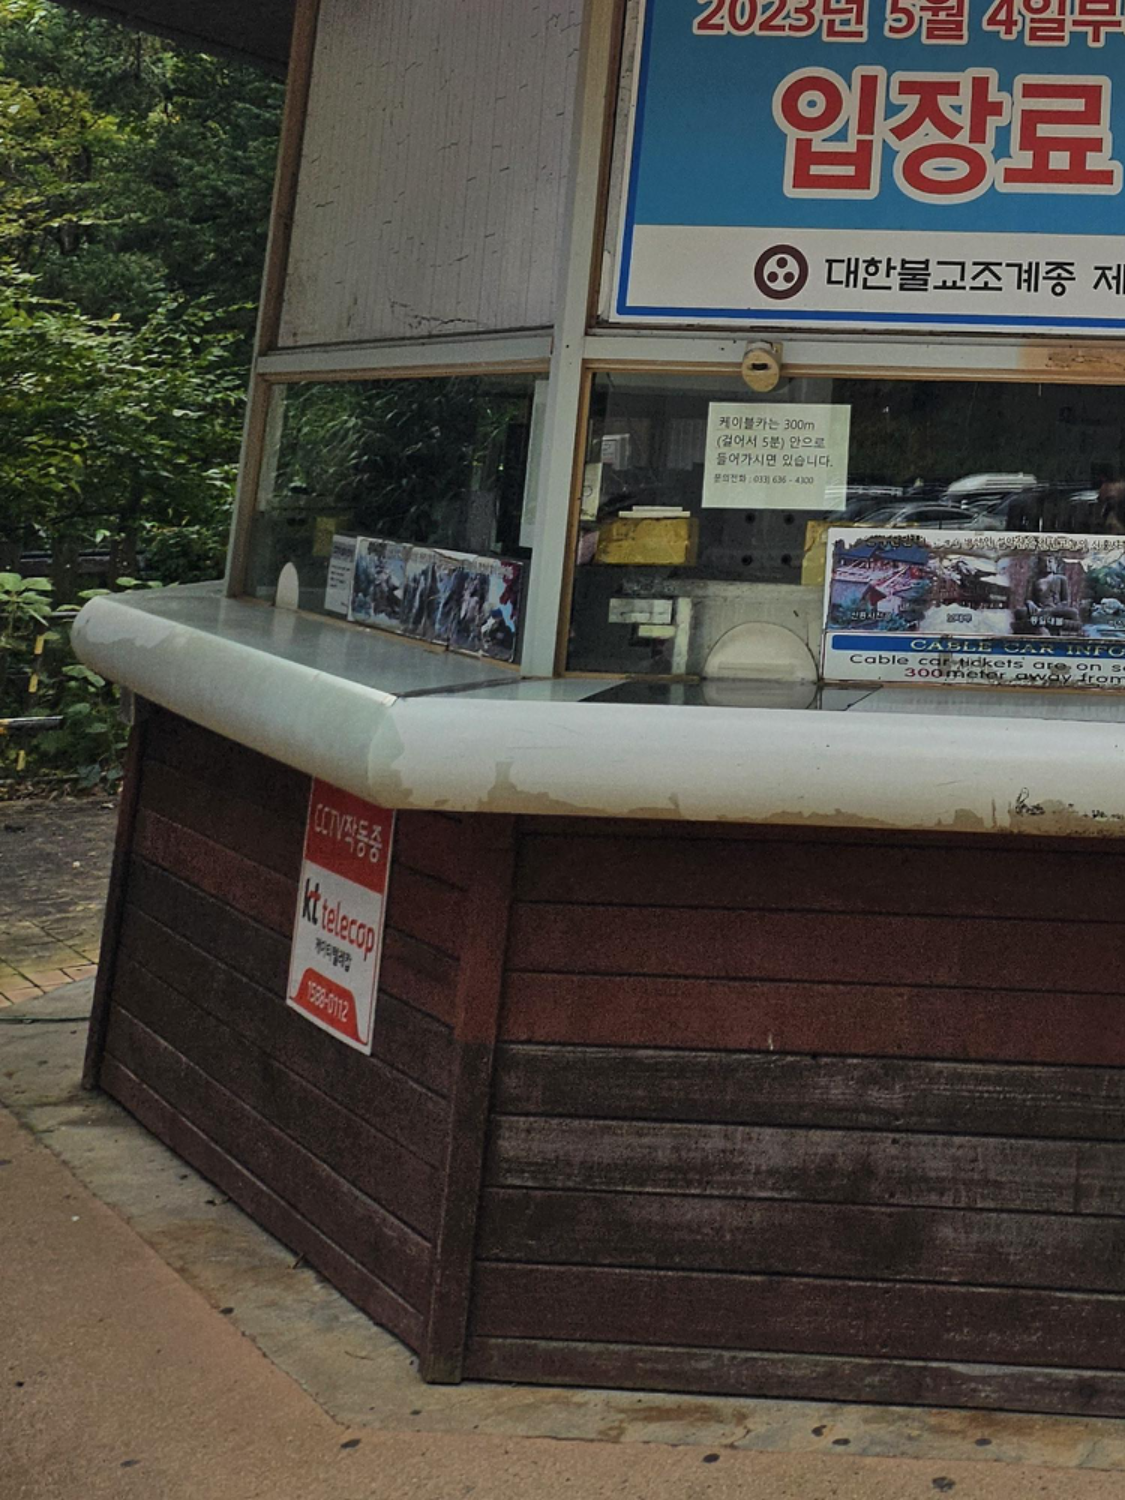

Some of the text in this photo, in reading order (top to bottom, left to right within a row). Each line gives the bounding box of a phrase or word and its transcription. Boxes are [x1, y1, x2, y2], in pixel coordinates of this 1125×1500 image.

[779, 71, 1117, 200] 입장료
[825, 256, 1076, 299] 대한불교조계종
[719, 416, 815, 431] 케이블카는 300m
[716, 434, 825, 450] (걸어서 5분) 안으로
[716, 452, 833, 468] 들어가시면 있습니다.
[714, 473, 747, 484] 문의전화
[772, 475, 787, 484] 636
[795, 476, 814, 484] 4300
[910, 638, 992, 652] CABLE
[1004, 642, 1052, 654] CAR
[850, 653, 909, 665] Cable
[918, 657, 947, 667] car
[959, 656, 1024, 669] tickets
[1032, 660, 1066, 670] are
[1076, 662, 1102, 672] on
[1015, 672, 1071, 683] away
[315, 803, 383, 863] CCTV작동중
[303, 878, 375, 962] kt telecop
[307, 980, 350, 1022] 1588-0112
